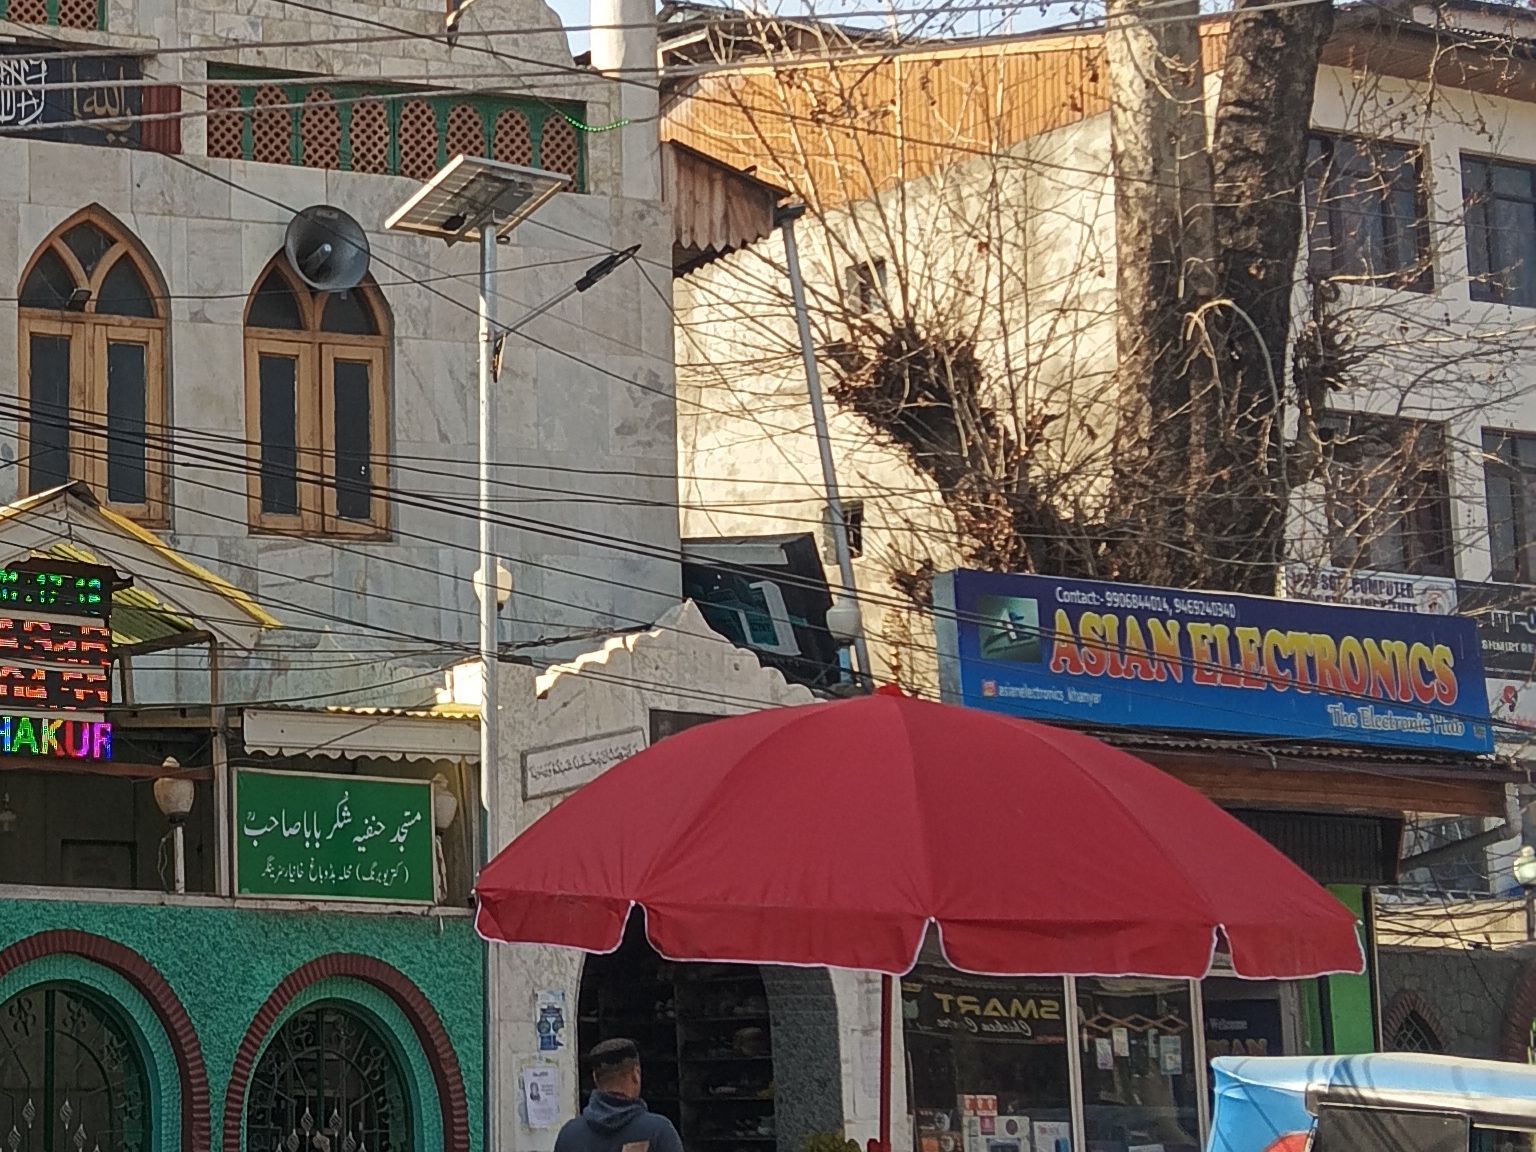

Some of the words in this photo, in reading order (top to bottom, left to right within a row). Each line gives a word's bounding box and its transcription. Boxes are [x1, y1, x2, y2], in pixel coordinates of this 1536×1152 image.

[1049, 608, 1183, 683] ASIAN
[1187, 622, 1458, 706] ELECTRONICS
[1328, 703, 1358, 728] The
[1359, 705, 1432, 733] Electronic
[1432, 714, 1464, 736] Hub
[389, 810, 422, 852] مسجد
